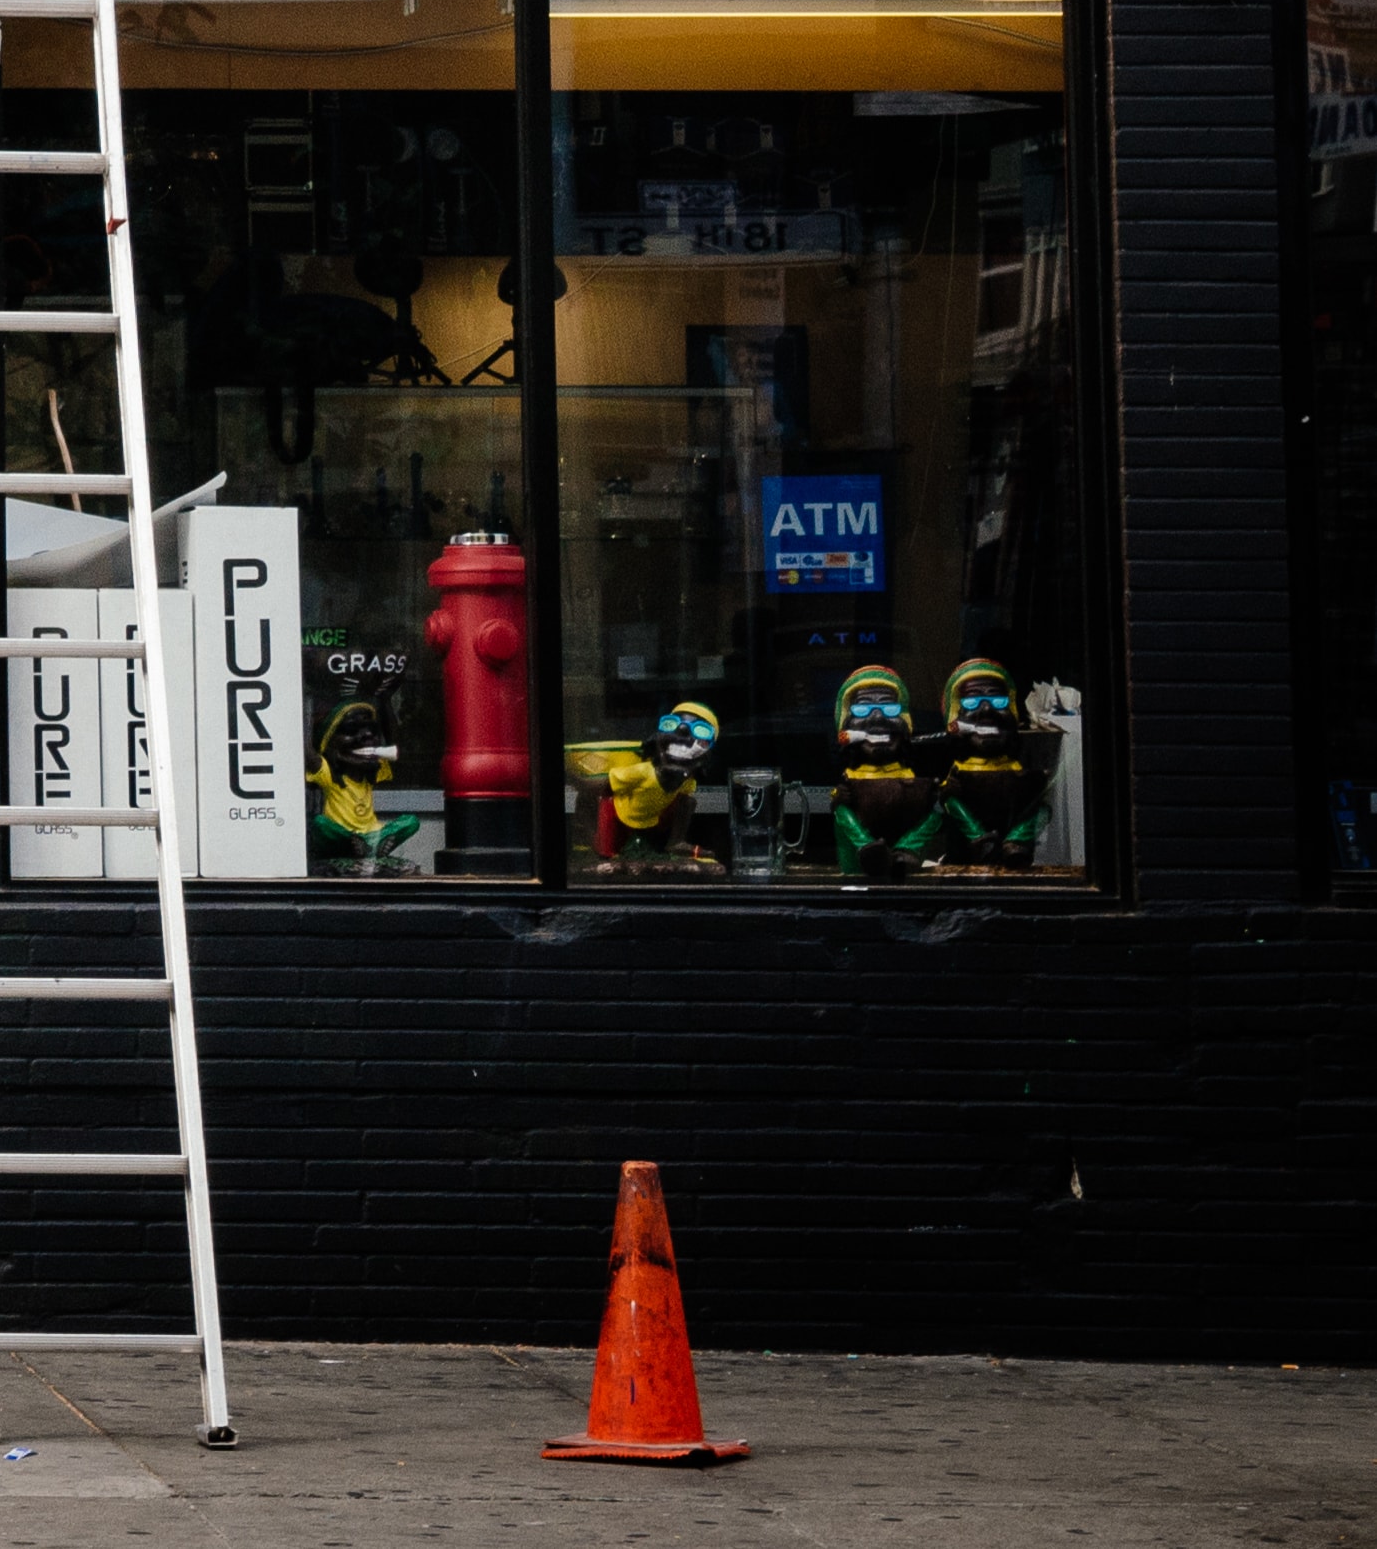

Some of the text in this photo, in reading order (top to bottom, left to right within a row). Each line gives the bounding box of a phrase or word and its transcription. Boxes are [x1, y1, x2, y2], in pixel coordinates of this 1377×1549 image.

[770, 502, 878, 537] ATM
[808, 632, 877, 645] ATM
[327, 653, 407, 675] GRASS
[222, 558, 275, 800] PURE
[229, 808, 276, 820] GLASS
